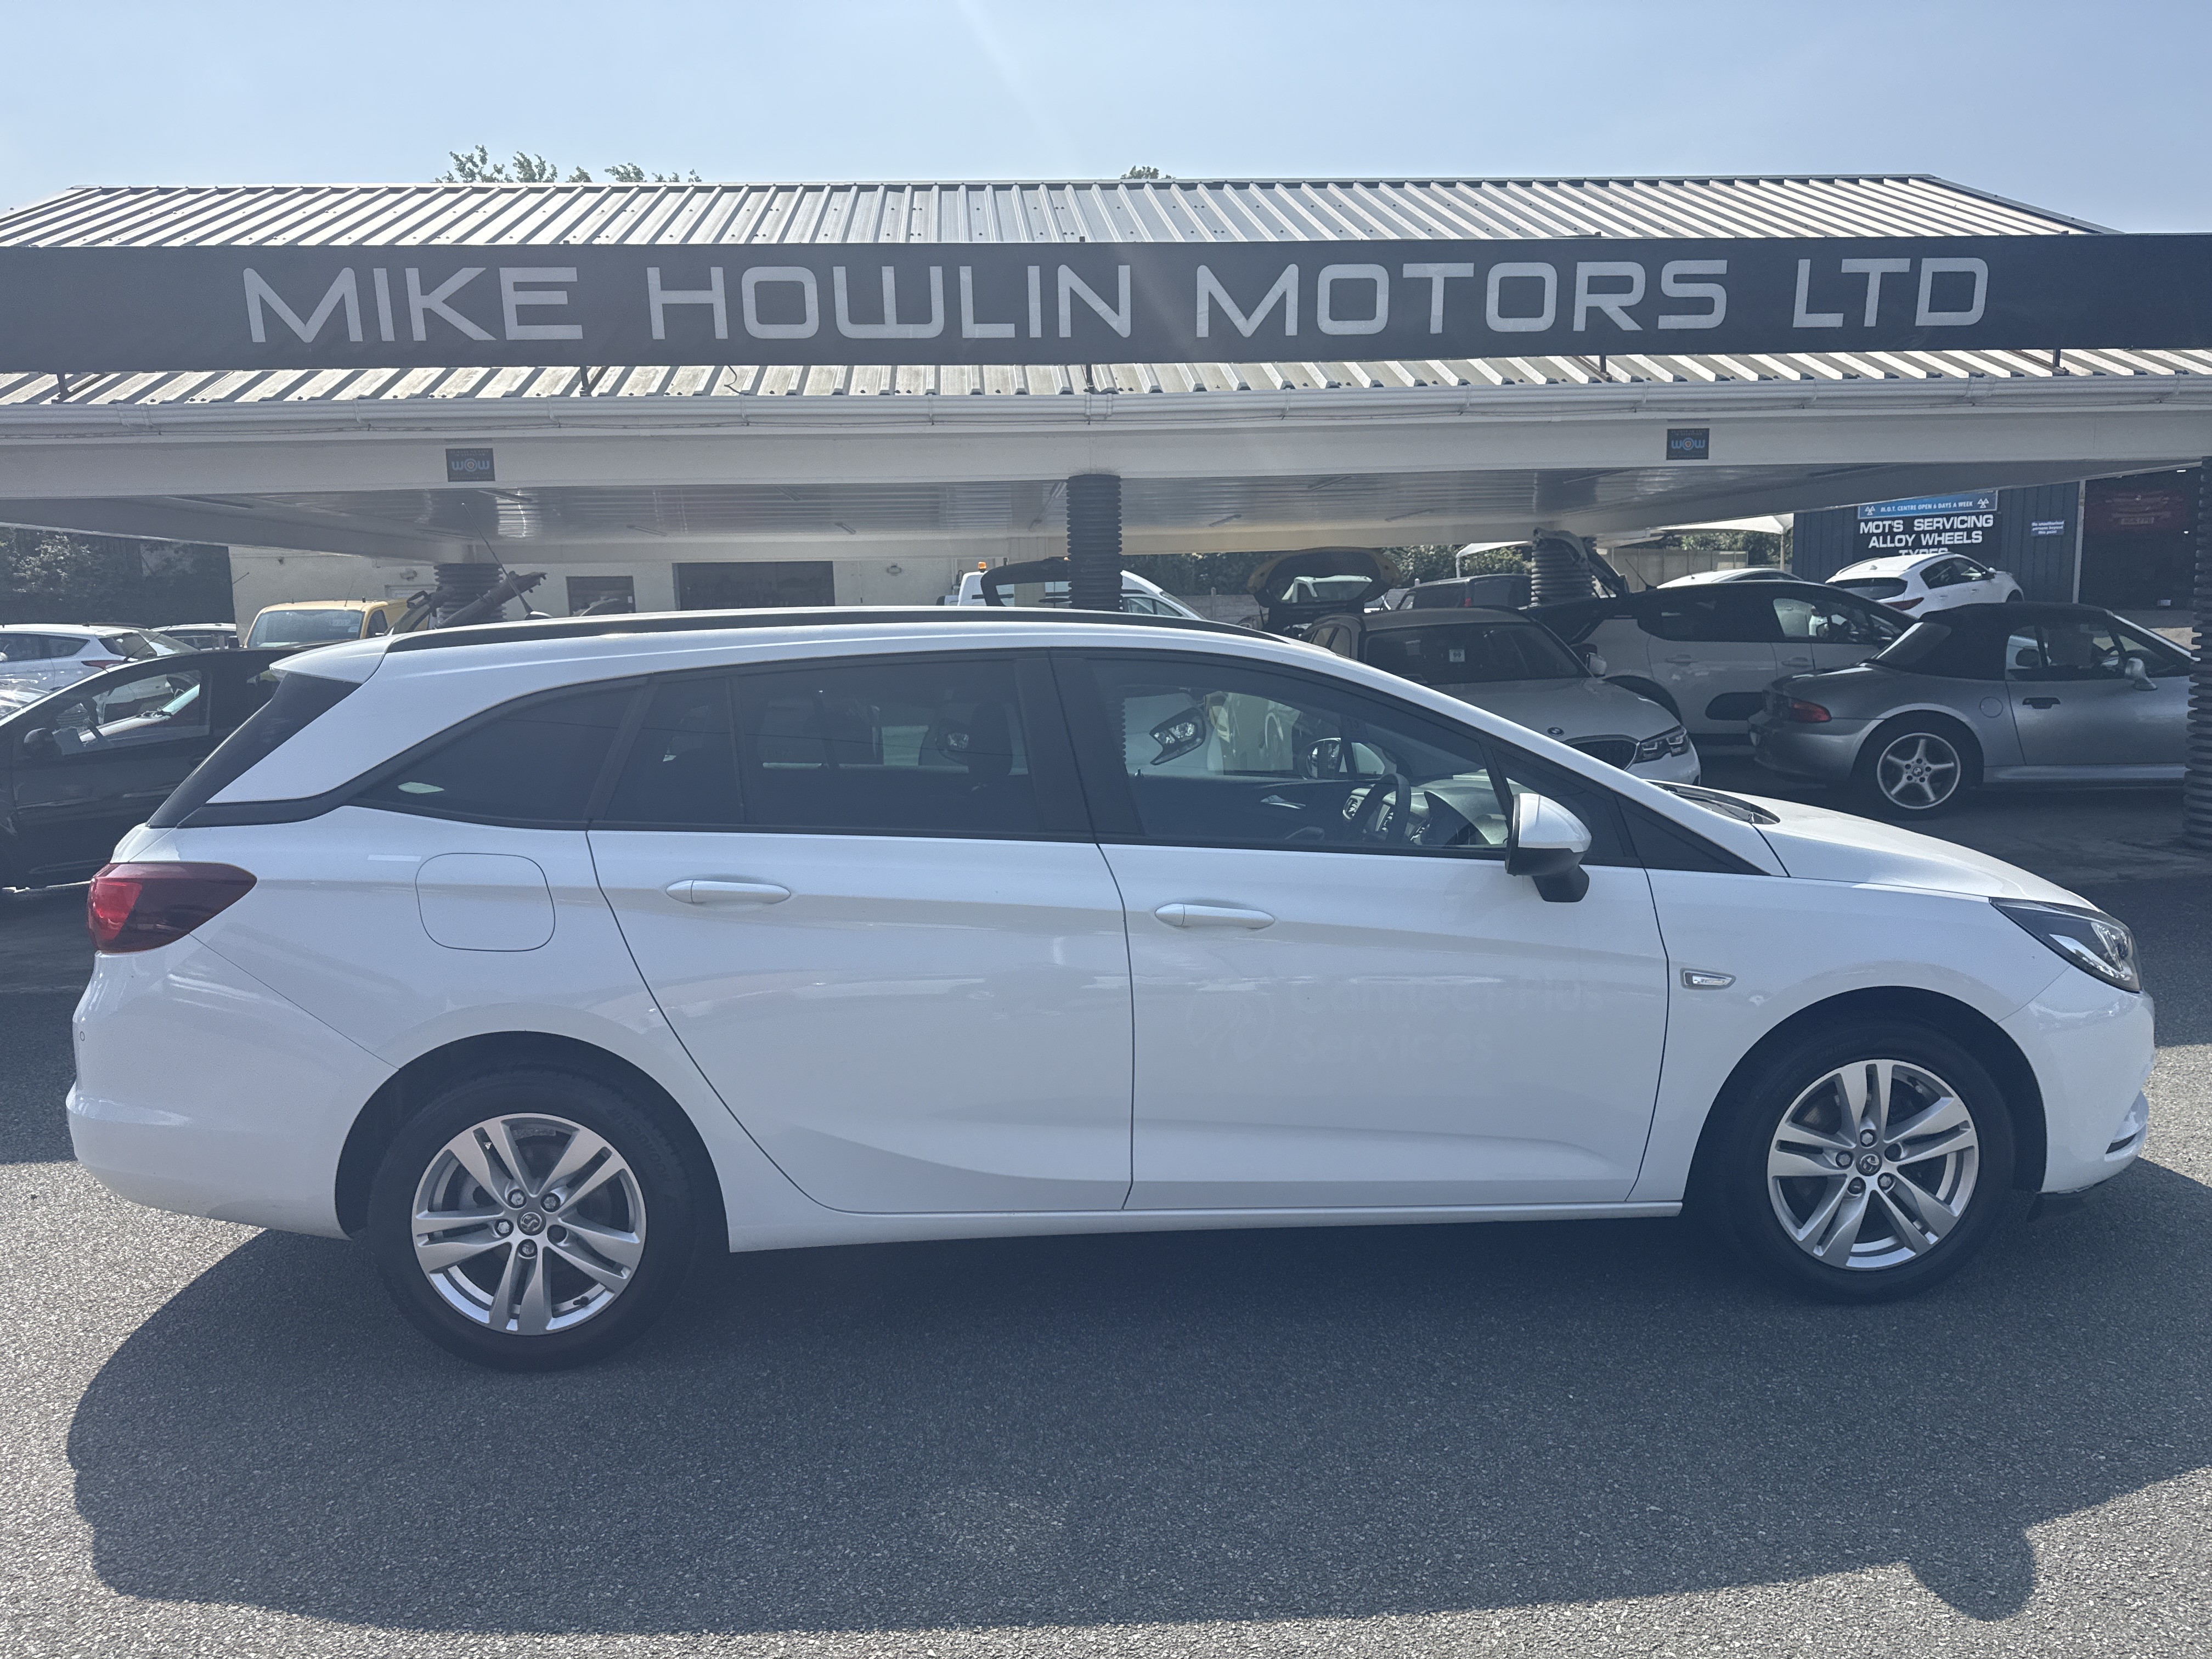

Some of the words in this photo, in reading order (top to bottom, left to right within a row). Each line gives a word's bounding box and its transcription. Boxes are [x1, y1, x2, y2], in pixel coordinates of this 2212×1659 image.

[242, 267, 583, 342] MIKE
[647, 264, 1132, 340] HOWLIN
[1196, 258, 1728, 338] MOTORS
[1792, 257, 1989, 328] LTD
[1859, 520, 1904, 534] MOT'S
[1914, 515, 1994, 531] SERVICING
[1868, 534, 1916, 549] ALLOY
[1921, 530, 1983, 546] WHEELS
